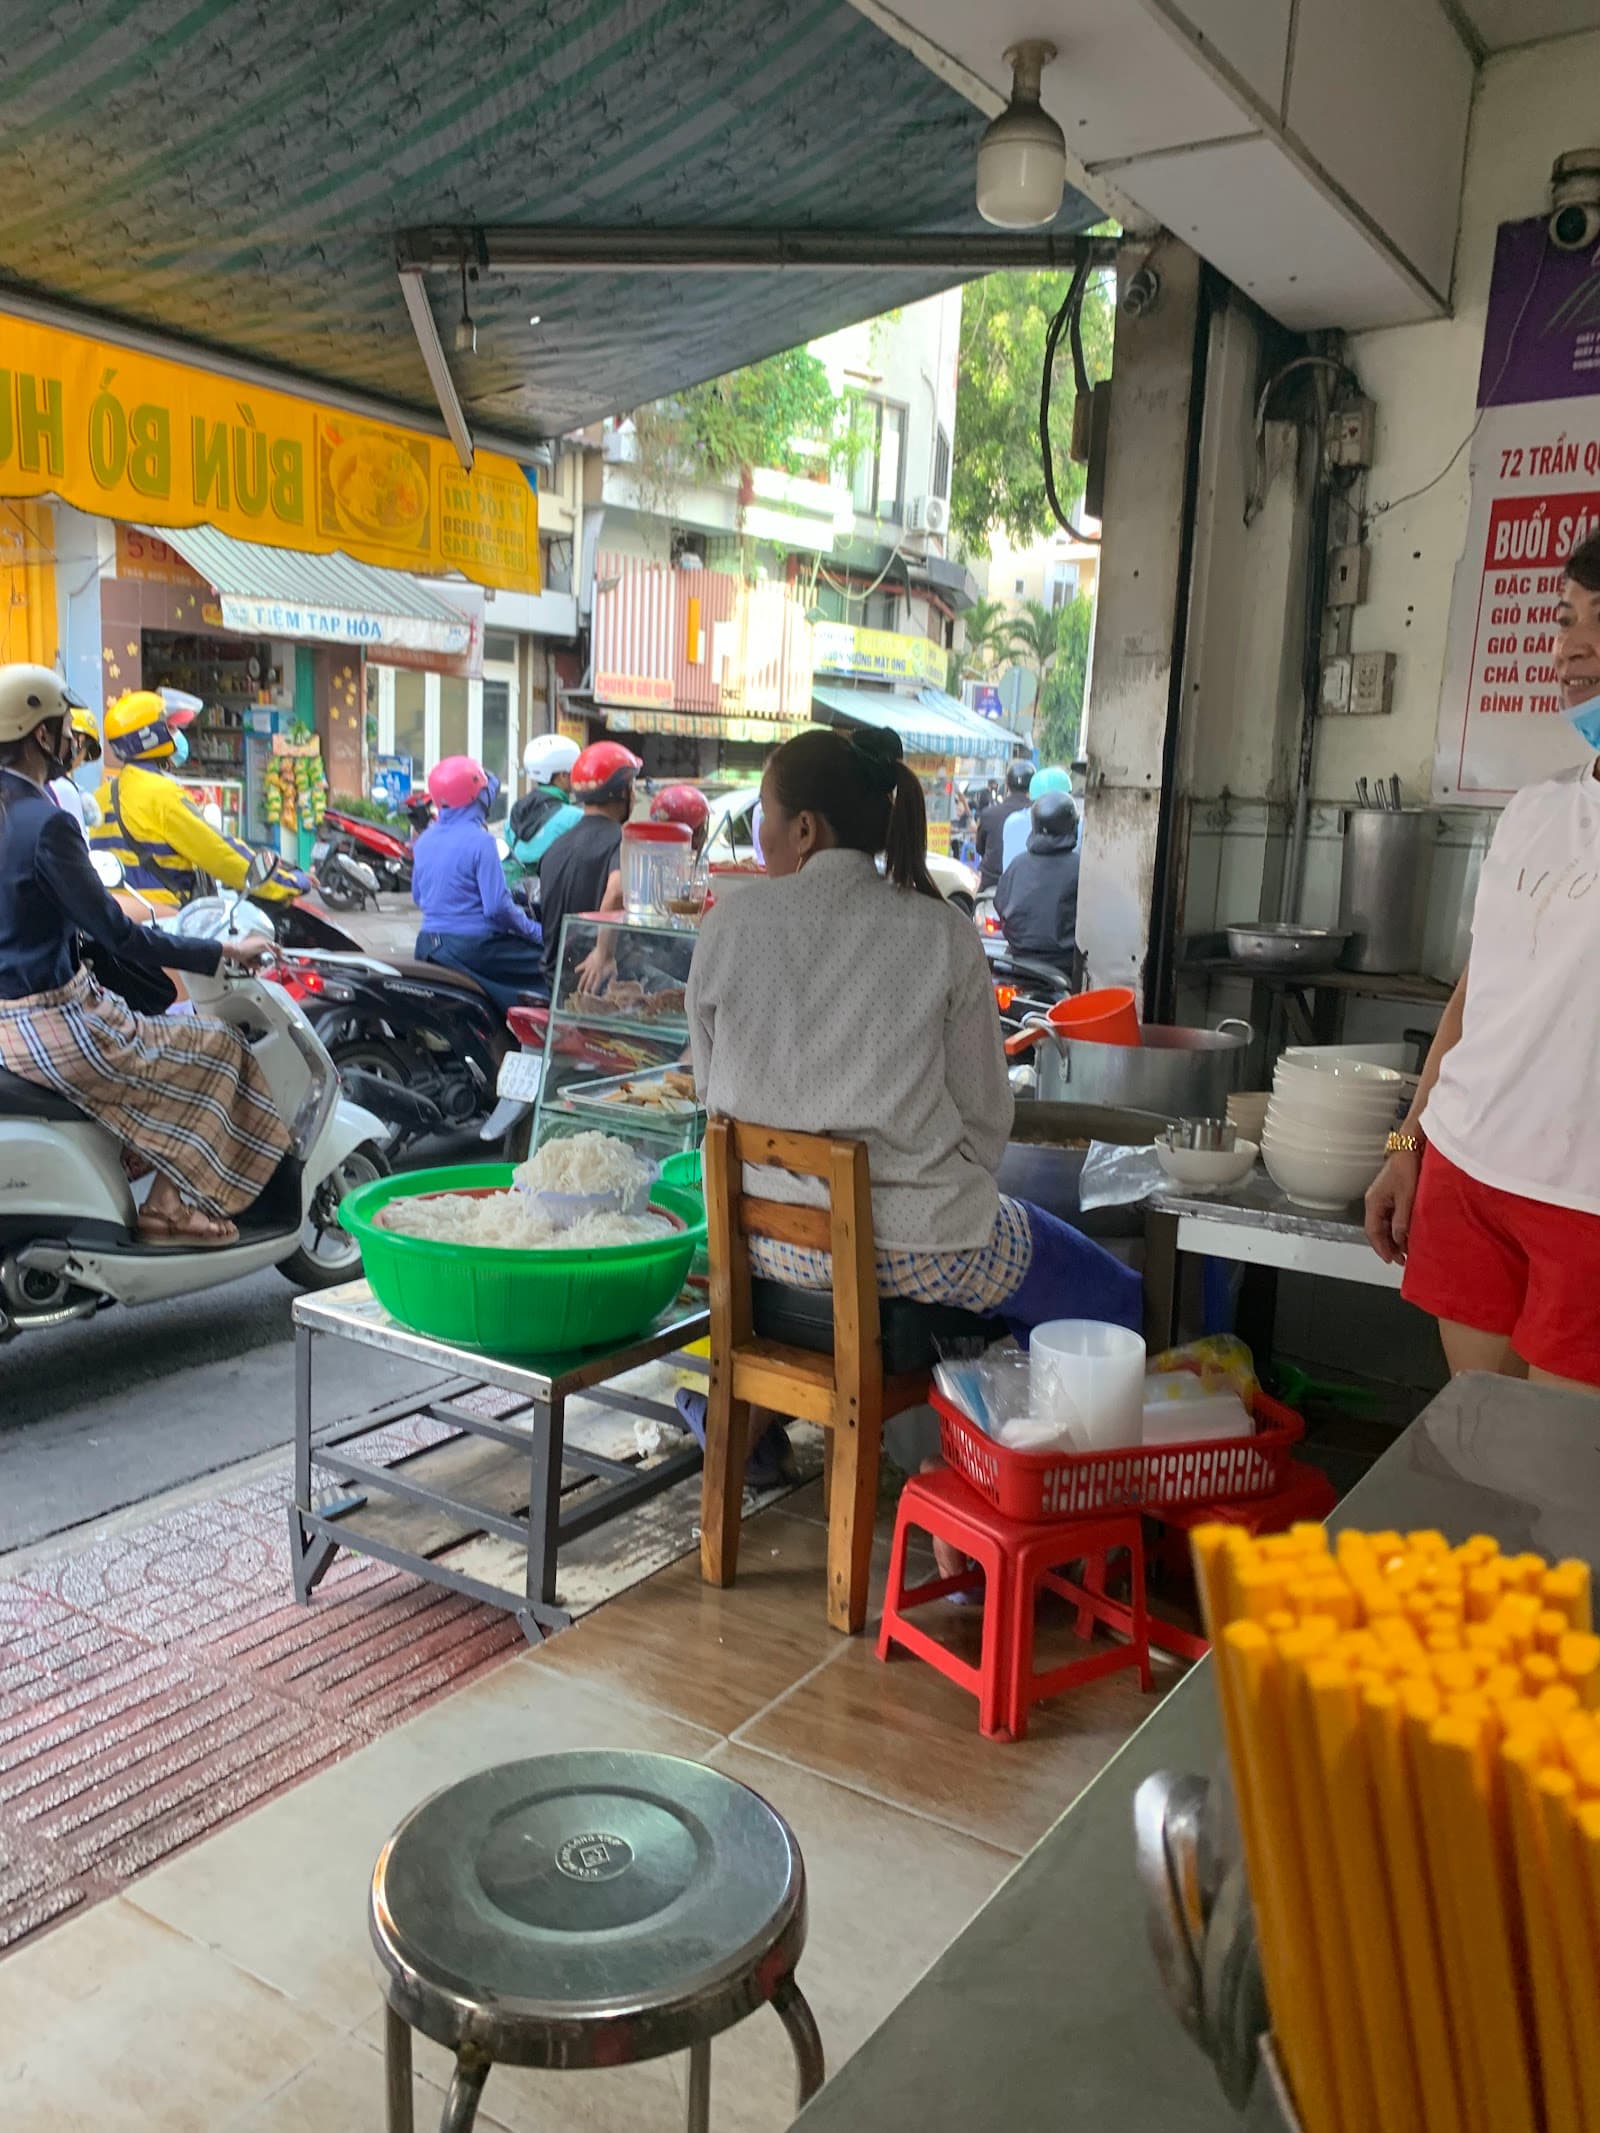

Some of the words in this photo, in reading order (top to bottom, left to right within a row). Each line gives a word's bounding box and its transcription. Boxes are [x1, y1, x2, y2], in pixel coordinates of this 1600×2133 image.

[1500, 448, 1523, 478] 72
[1494, 501, 1551, 561] BUỔI
[346, 615, 382, 639] HÓA
[1480, 691, 1524, 713] BÌNH
